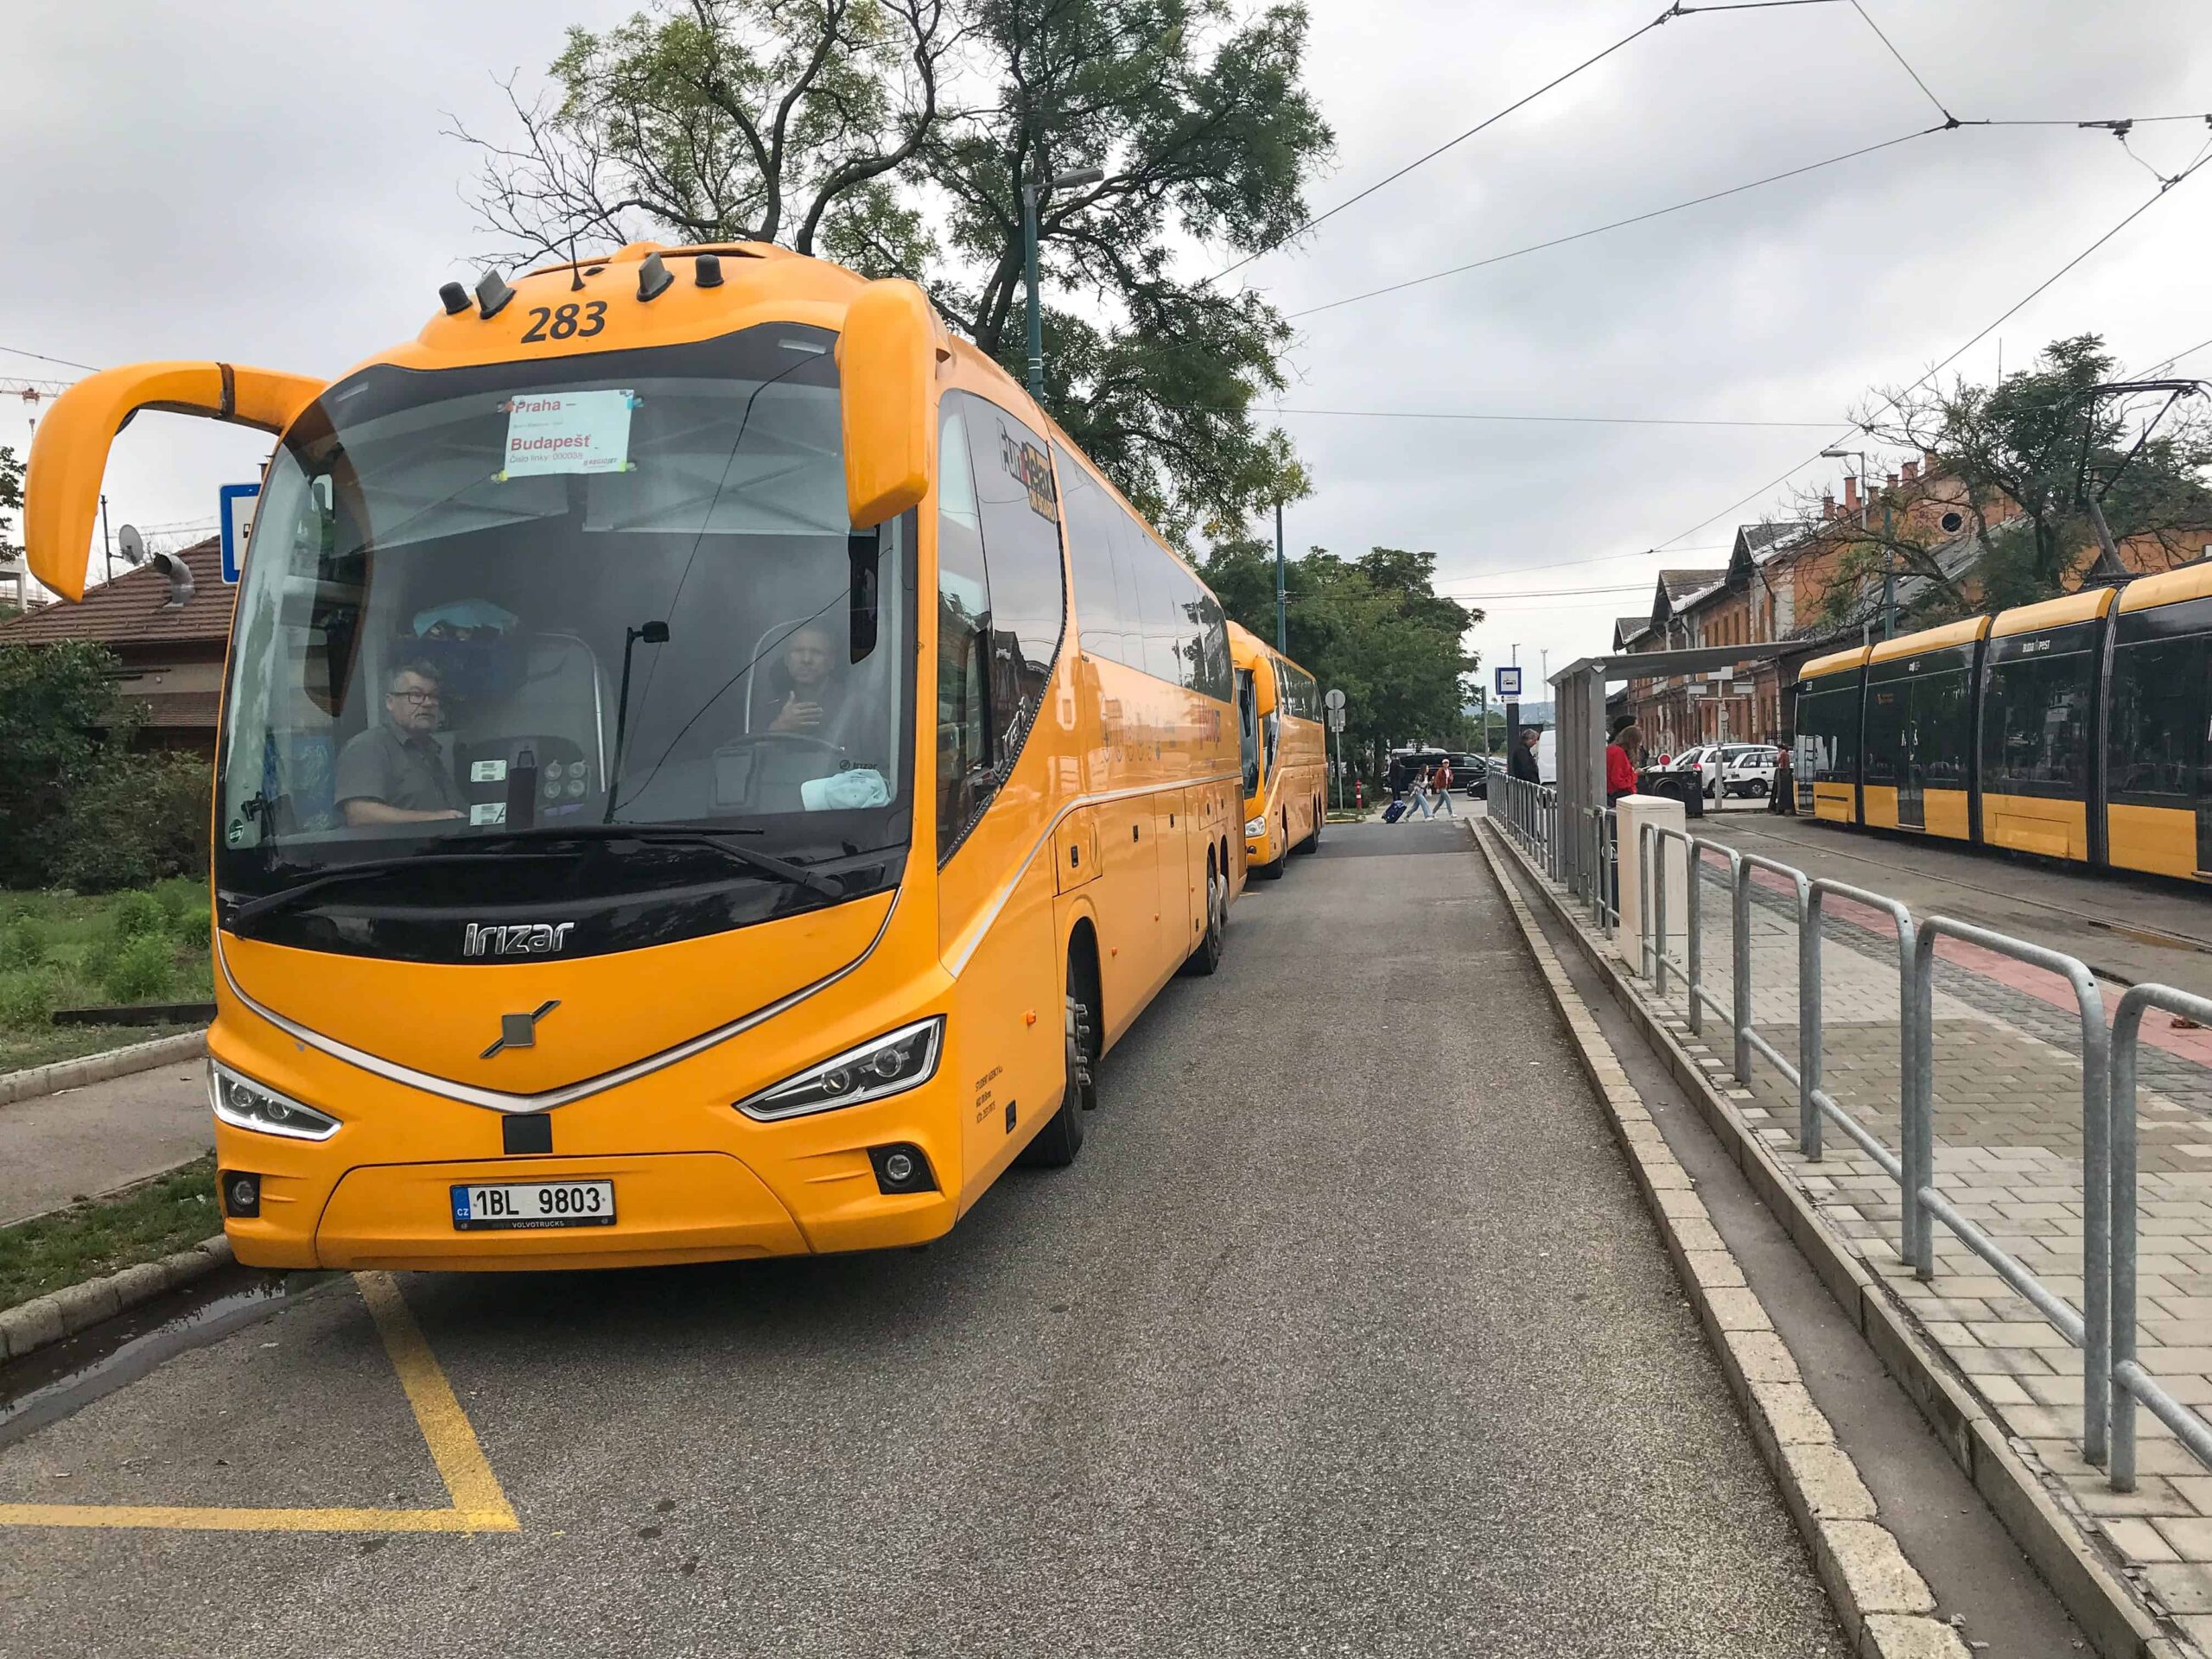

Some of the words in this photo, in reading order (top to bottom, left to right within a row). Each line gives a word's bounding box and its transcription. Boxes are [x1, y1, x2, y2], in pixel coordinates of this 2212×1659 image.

[520, 300, 607, 344] 283
[515, 399, 561, 413] Praha
[511, 434, 592, 452] Budapešť
[463, 921, 575, 957] Irizar
[457, 1208, 469, 1217] CZ
[476, 1189, 519, 1216] 1BL
[538, 1186, 601, 1214] 9803
[512, 1220, 565, 1229] VOLVOTRUCKS
